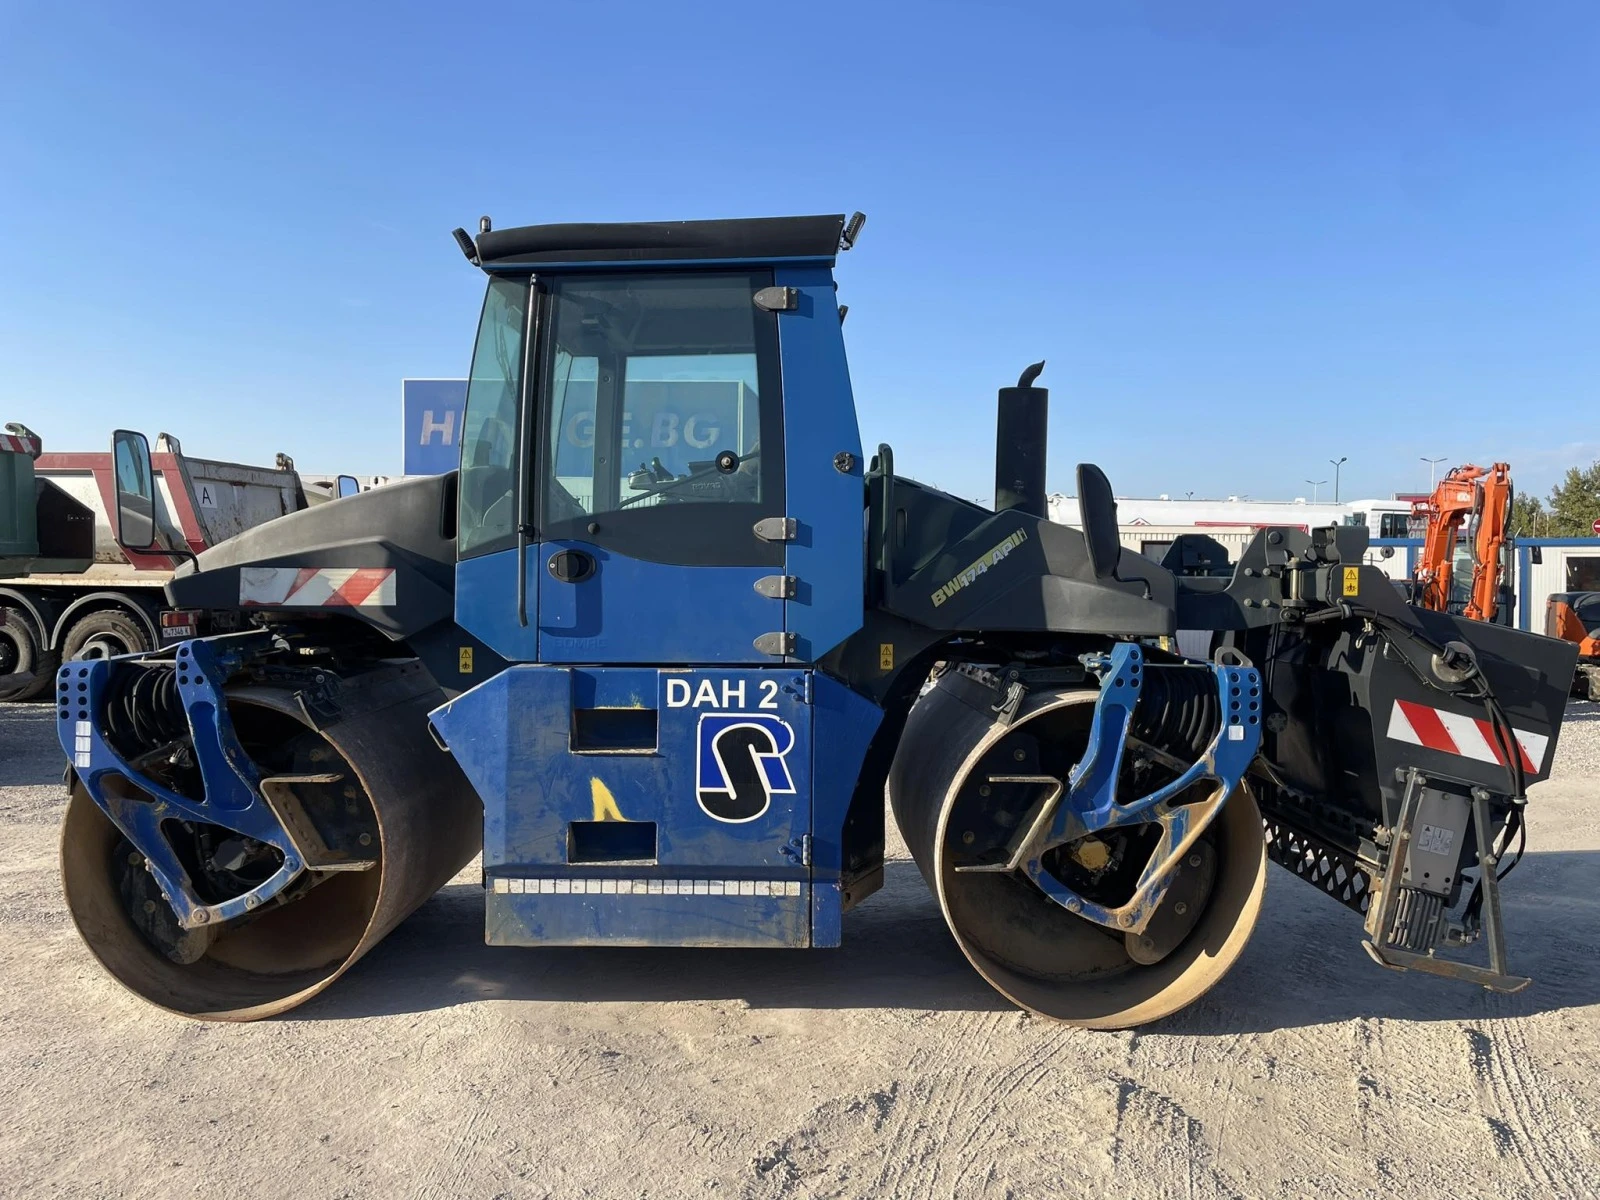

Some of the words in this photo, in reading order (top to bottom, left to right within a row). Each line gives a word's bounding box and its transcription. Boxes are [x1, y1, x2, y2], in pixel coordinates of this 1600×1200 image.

[202, 486, 212, 504] A
[666, 679, 746, 708] DAH
[758, 680, 778, 709] 2
